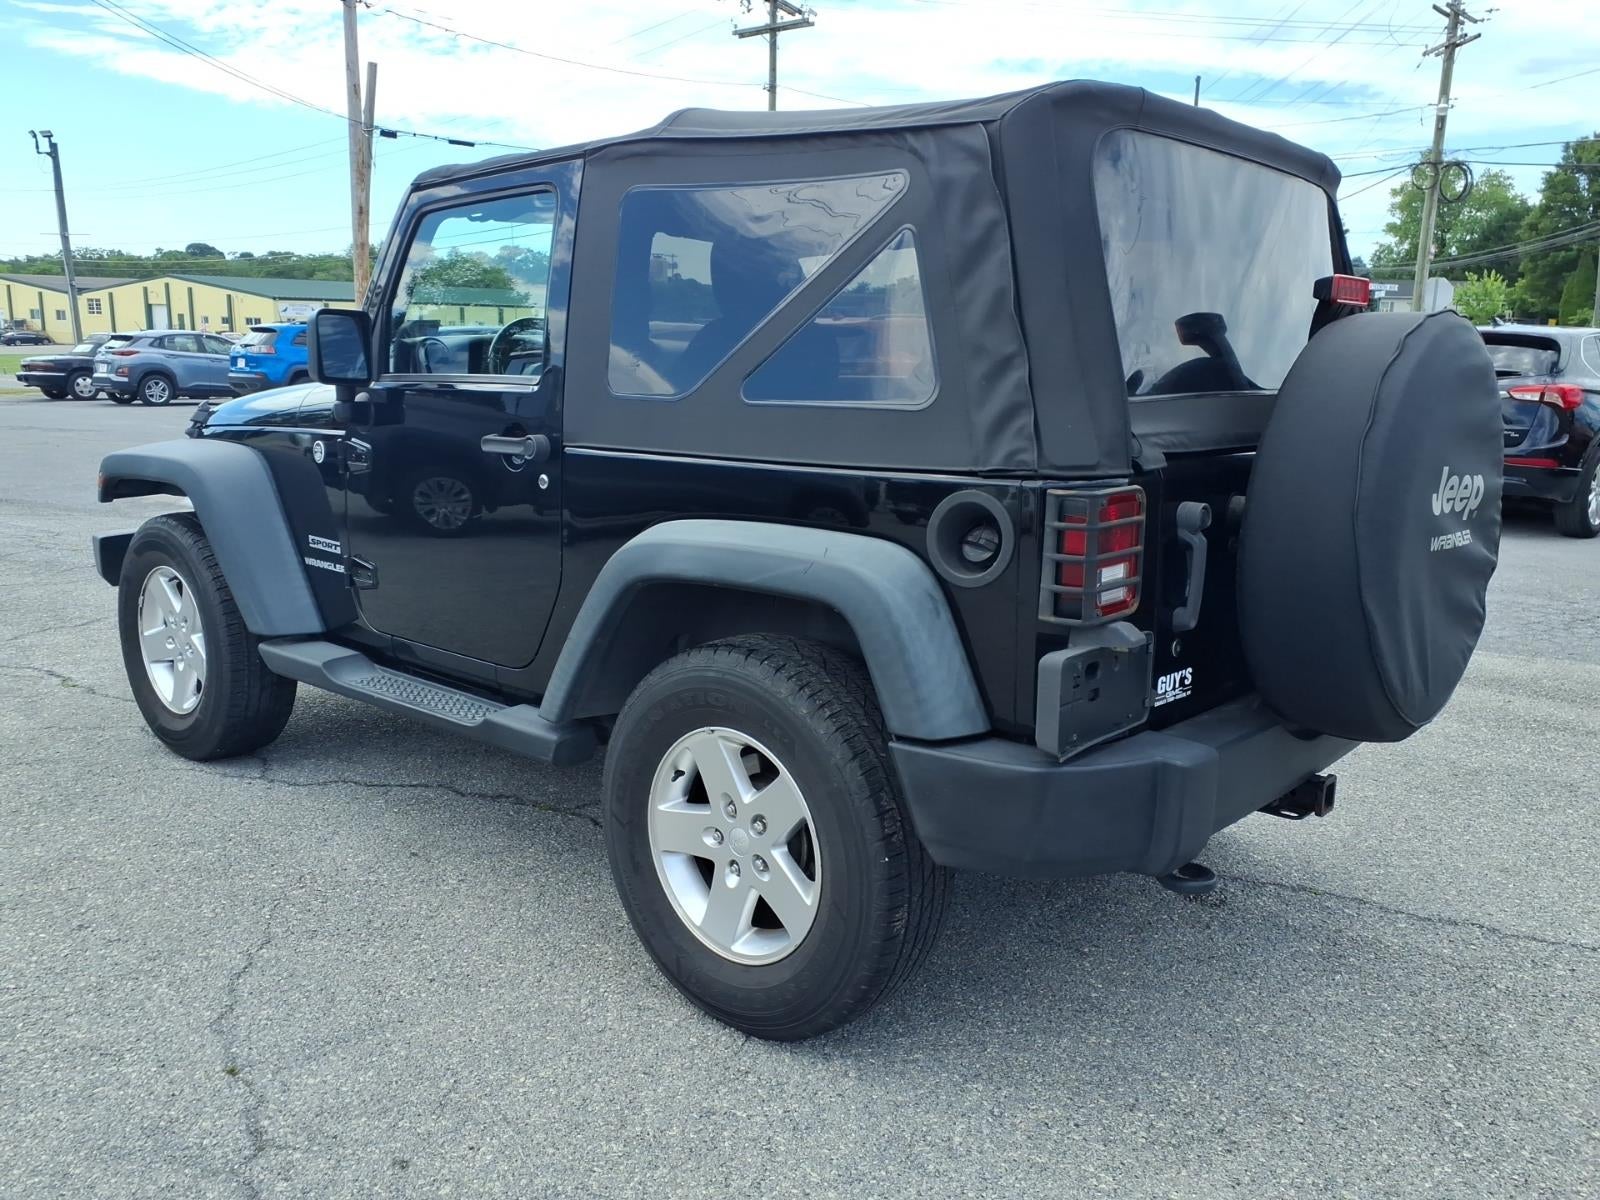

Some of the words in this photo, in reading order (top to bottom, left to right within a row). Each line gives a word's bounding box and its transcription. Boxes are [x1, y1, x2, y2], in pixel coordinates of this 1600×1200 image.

[1431, 466, 1485, 521] Jeep
[309, 536, 341, 553] SPORT
[1157, 667, 1193, 694] GUY'S
